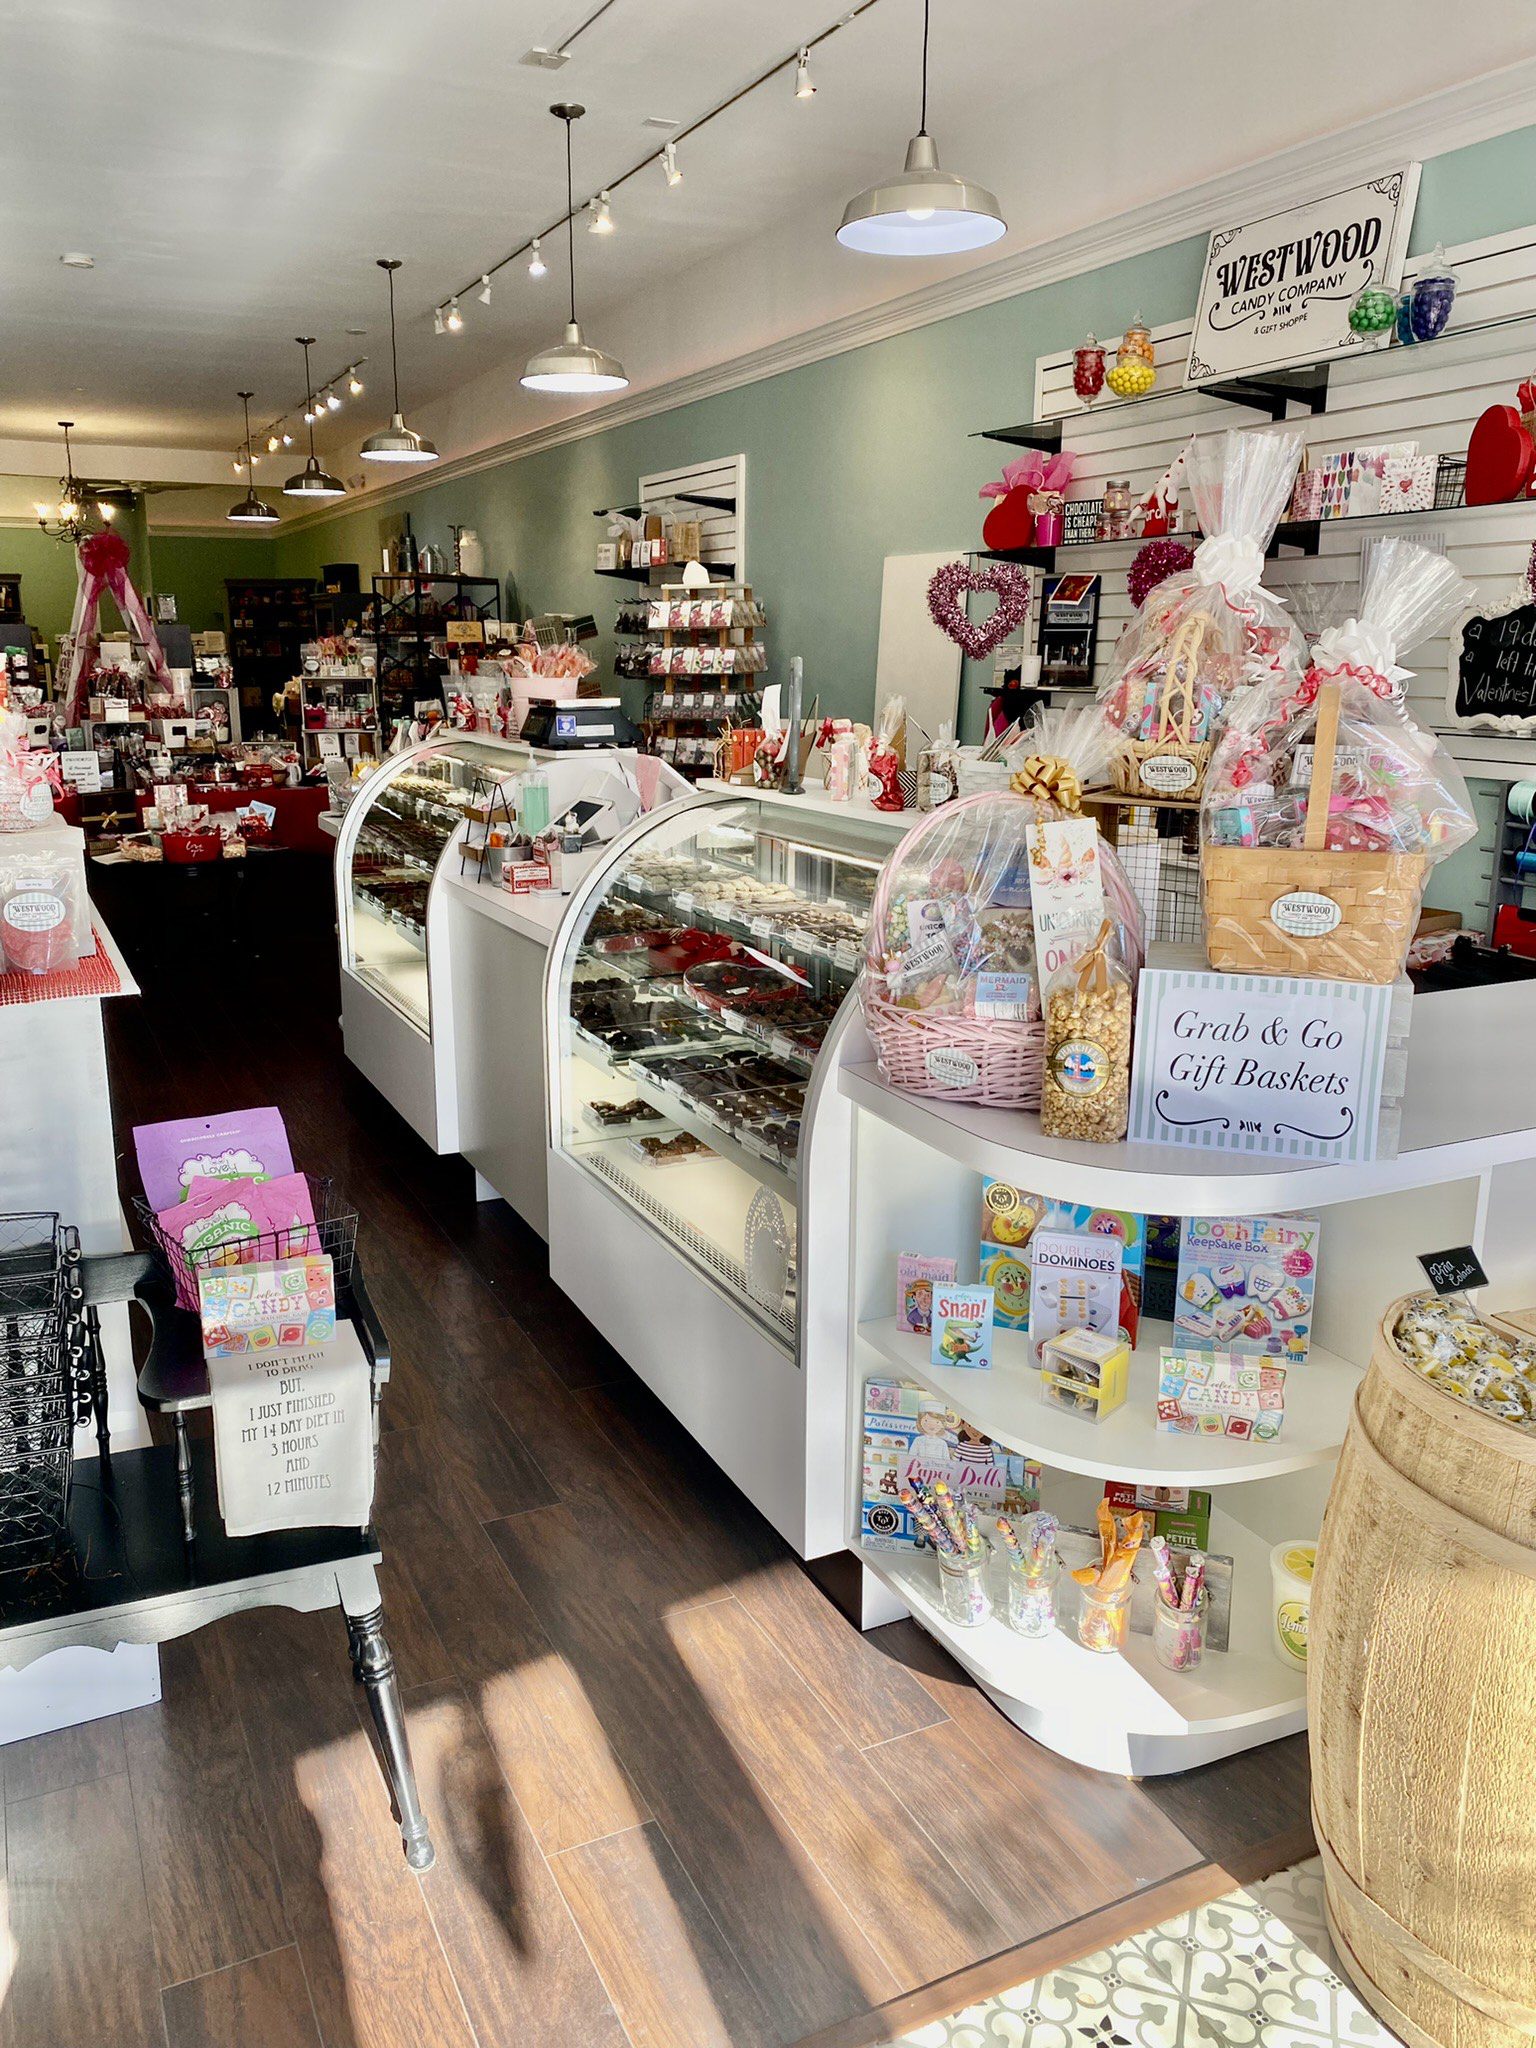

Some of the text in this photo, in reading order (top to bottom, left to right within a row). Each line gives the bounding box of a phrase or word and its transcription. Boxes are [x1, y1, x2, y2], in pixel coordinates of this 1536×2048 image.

[1216, 217, 1382, 299] WESTWOOD
[1231, 271, 1347, 315] CANDY COMPANY
[1253, 313, 1309, 335] & GIFT SHOPPE
[1064, 501, 1103, 516] CHOCOLATE
[1064, 517, 1071, 529] IS
[1064, 528, 1095, 539] THAN THERA
[1499, 620, 1521, 646] 19
[1496, 650, 1520, 673] left
[1463, 672, 1530, 706] Valentine's
[12, 904, 56, 914] WESTWOOD
[1281, 902, 1331, 915] WESTWOOD
[903, 943, 945, 973] WESTWOOD
[980, 976, 1027, 985] MERMAID
[1173, 1009, 1343, 1050] Grab & Go
[933, 1055, 971, 1070] WESTWOOD
[1169, 1052, 1350, 1096] Gift Baskets
[200, 1159, 239, 1176] Lovely
[196, 1212, 230, 1234] Lovely
[1251, 1220, 1315, 1250] Fairy
[1039, 1242, 1114, 1259] DOUBLE SIX
[1245, 1241, 1269, 1253] Box
[1039, 1253, 1115, 1271] DOMINOES
[900, 1267, 949, 1282] old maid
[1449, 1263, 1476, 1286] Colada
[232, 1295, 303, 1318] CANDY
[938, 1298, 987, 1322] Snap!
[248, 1363, 253, 1371] I
[266, 1369, 279, 1377] TO
[250, 1392, 336, 1421] I JUST FINISHED
[1187, 1386, 1255, 1407] CANDY
[242, 1409, 345, 1443] MY 14 DAY DIET IN
[271, 1434, 319, 1457] 3 HOURS
[286, 1457, 310, 1473] AND
[267, 1474, 332, 1496] 12 MINUTES
[959, 1465, 1001, 1489] Dolls
[1166, 1534, 1198, 1546] PETITE
